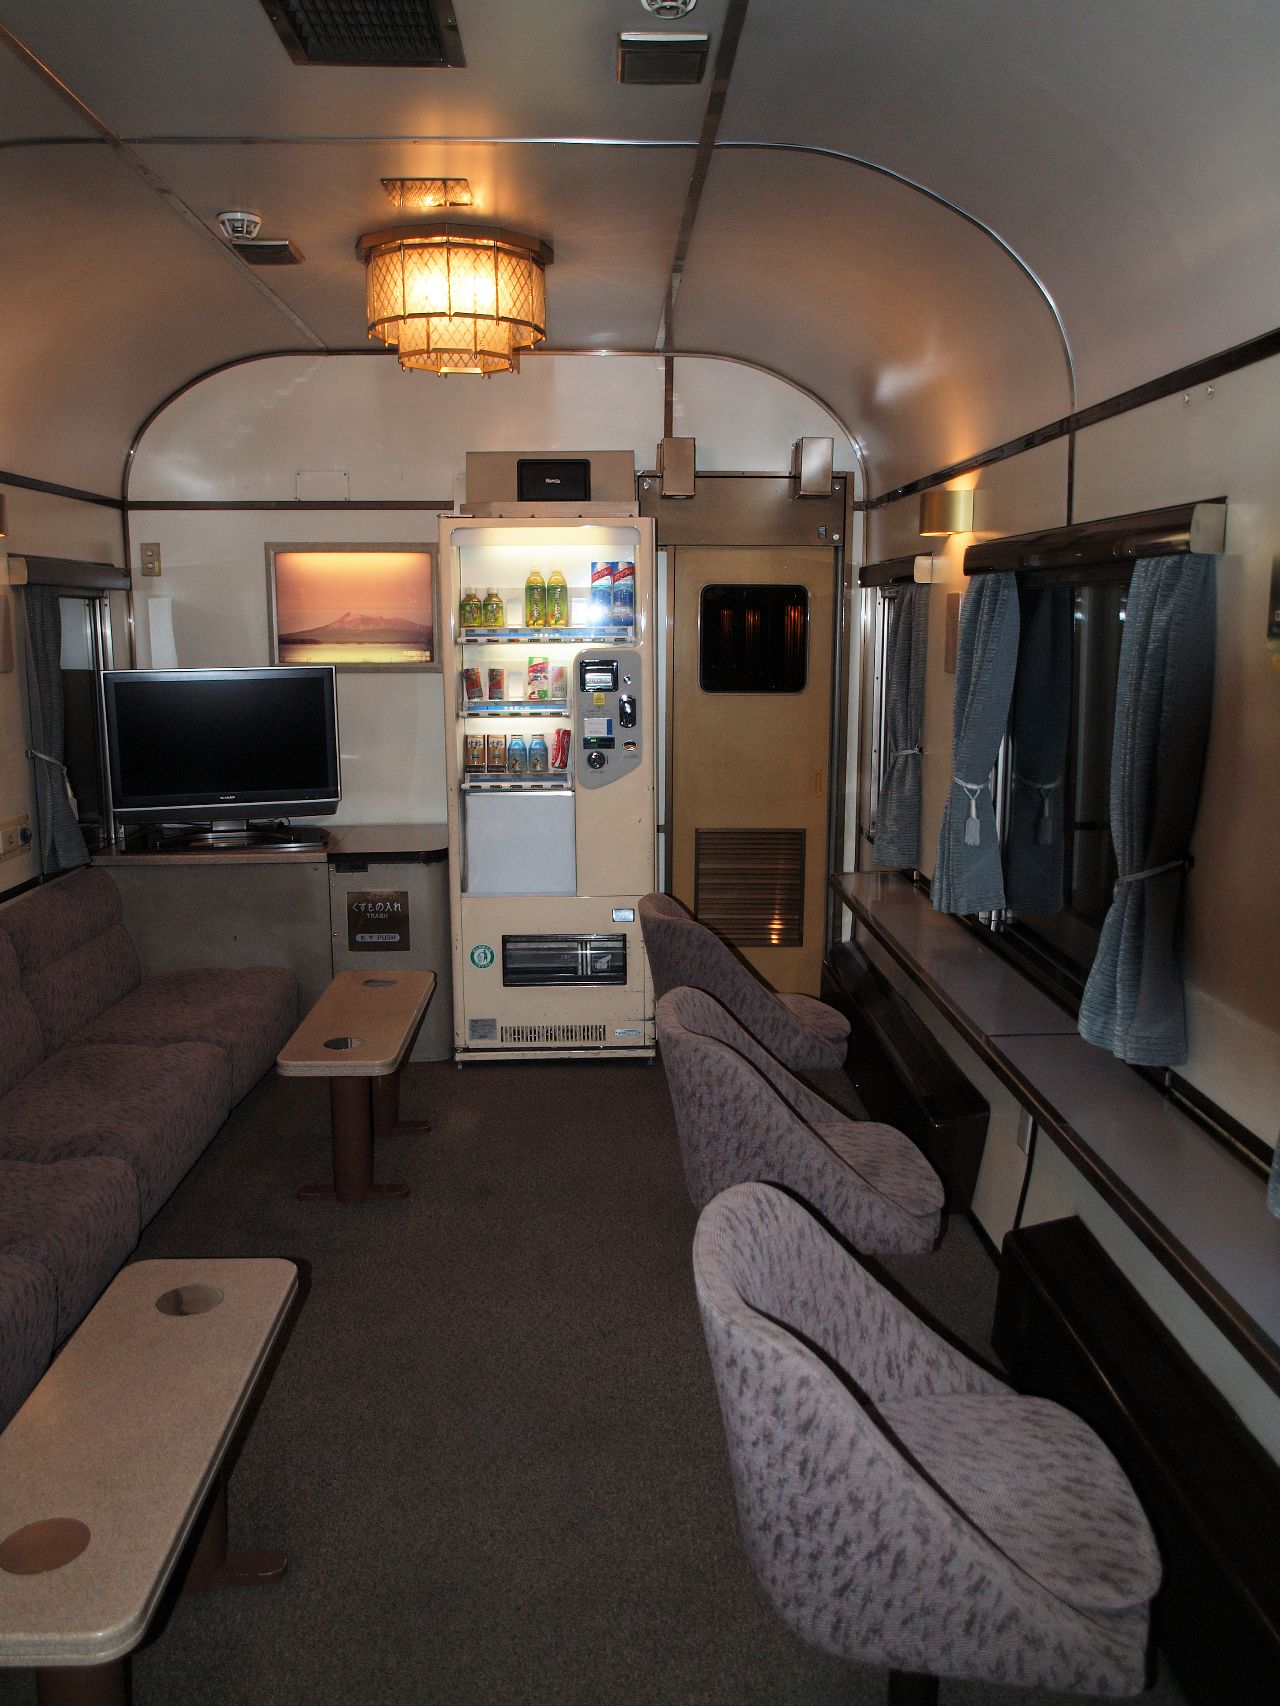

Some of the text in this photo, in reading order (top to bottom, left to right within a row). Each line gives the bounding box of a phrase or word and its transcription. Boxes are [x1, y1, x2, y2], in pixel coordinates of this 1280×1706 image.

[352, 902, 402, 912] くずもの入れ
